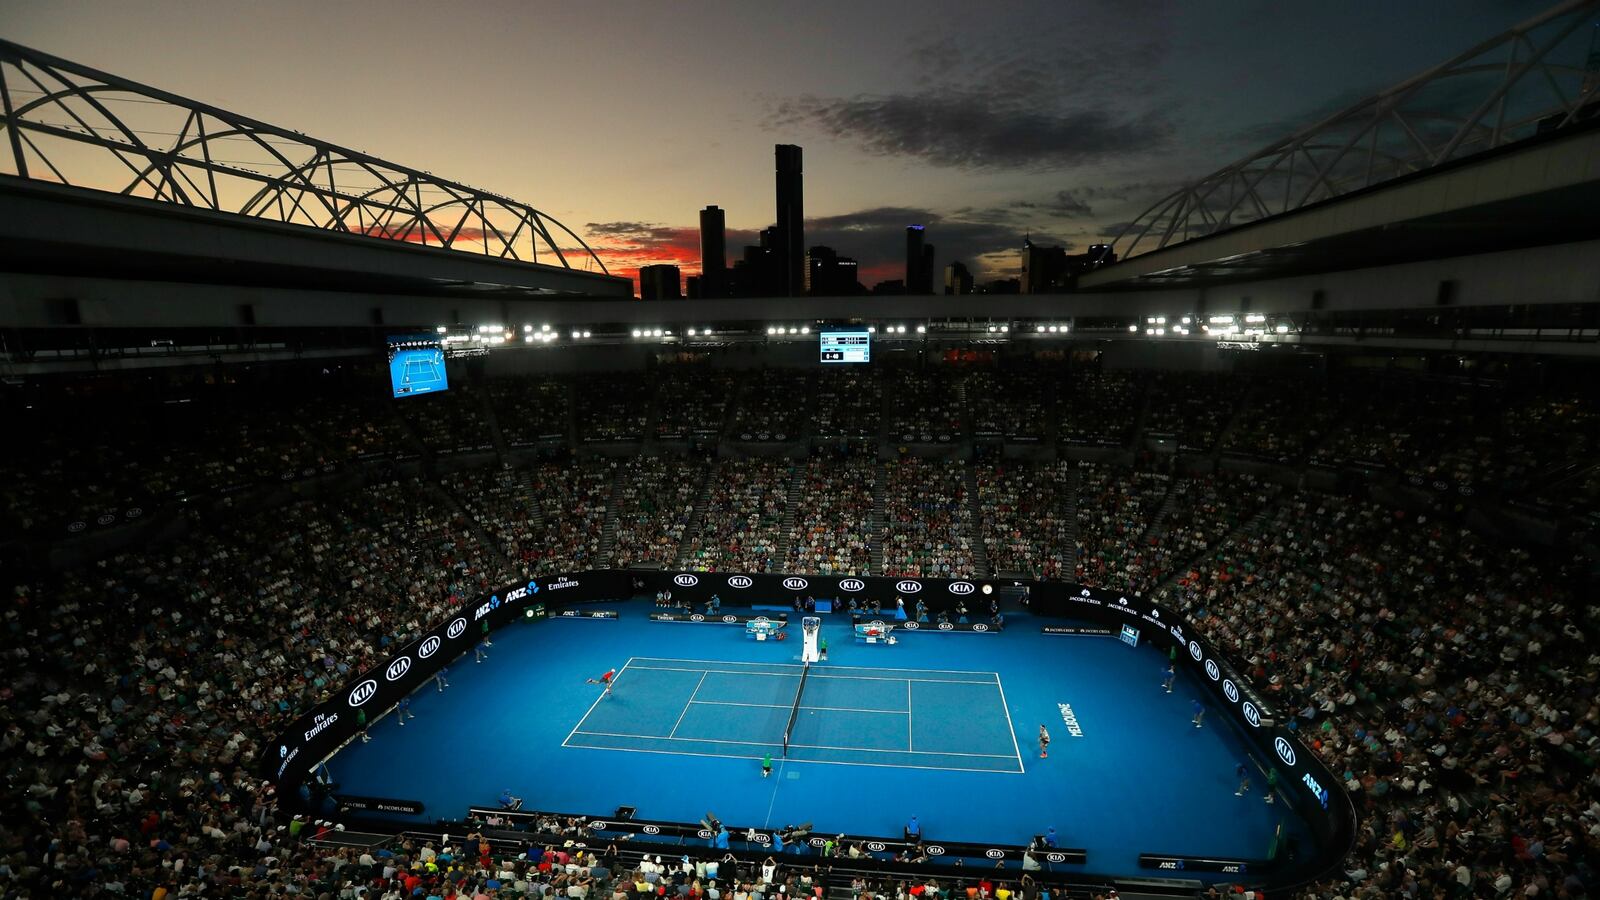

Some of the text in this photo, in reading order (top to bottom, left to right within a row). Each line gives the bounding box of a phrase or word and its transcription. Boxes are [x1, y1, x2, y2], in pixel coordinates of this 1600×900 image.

[548, 580, 579, 590] Emirates
[505, 587, 526, 603] ANZ
[474, 602, 490, 621] ANZ
[450, 620, 464, 636] KIA
[422, 638, 438, 656] KIA
[1191, 643, 1200, 660] KIA
[389, 660, 408, 678] KIA
[1207, 661, 1217, 679] KIA
[352, 683, 374, 704] KIA
[1224, 682, 1236, 700] KIA
[314, 713, 325, 723] Fly
[1057, 702, 1083, 737] MELBOURNE
[1245, 705, 1258, 725] KIA
[304, 712, 338, 741] Emirates
[1278, 740, 1292, 763] KIA
[1302, 773, 1322, 800] ANZ
[764, 869, 769, 877] 8
